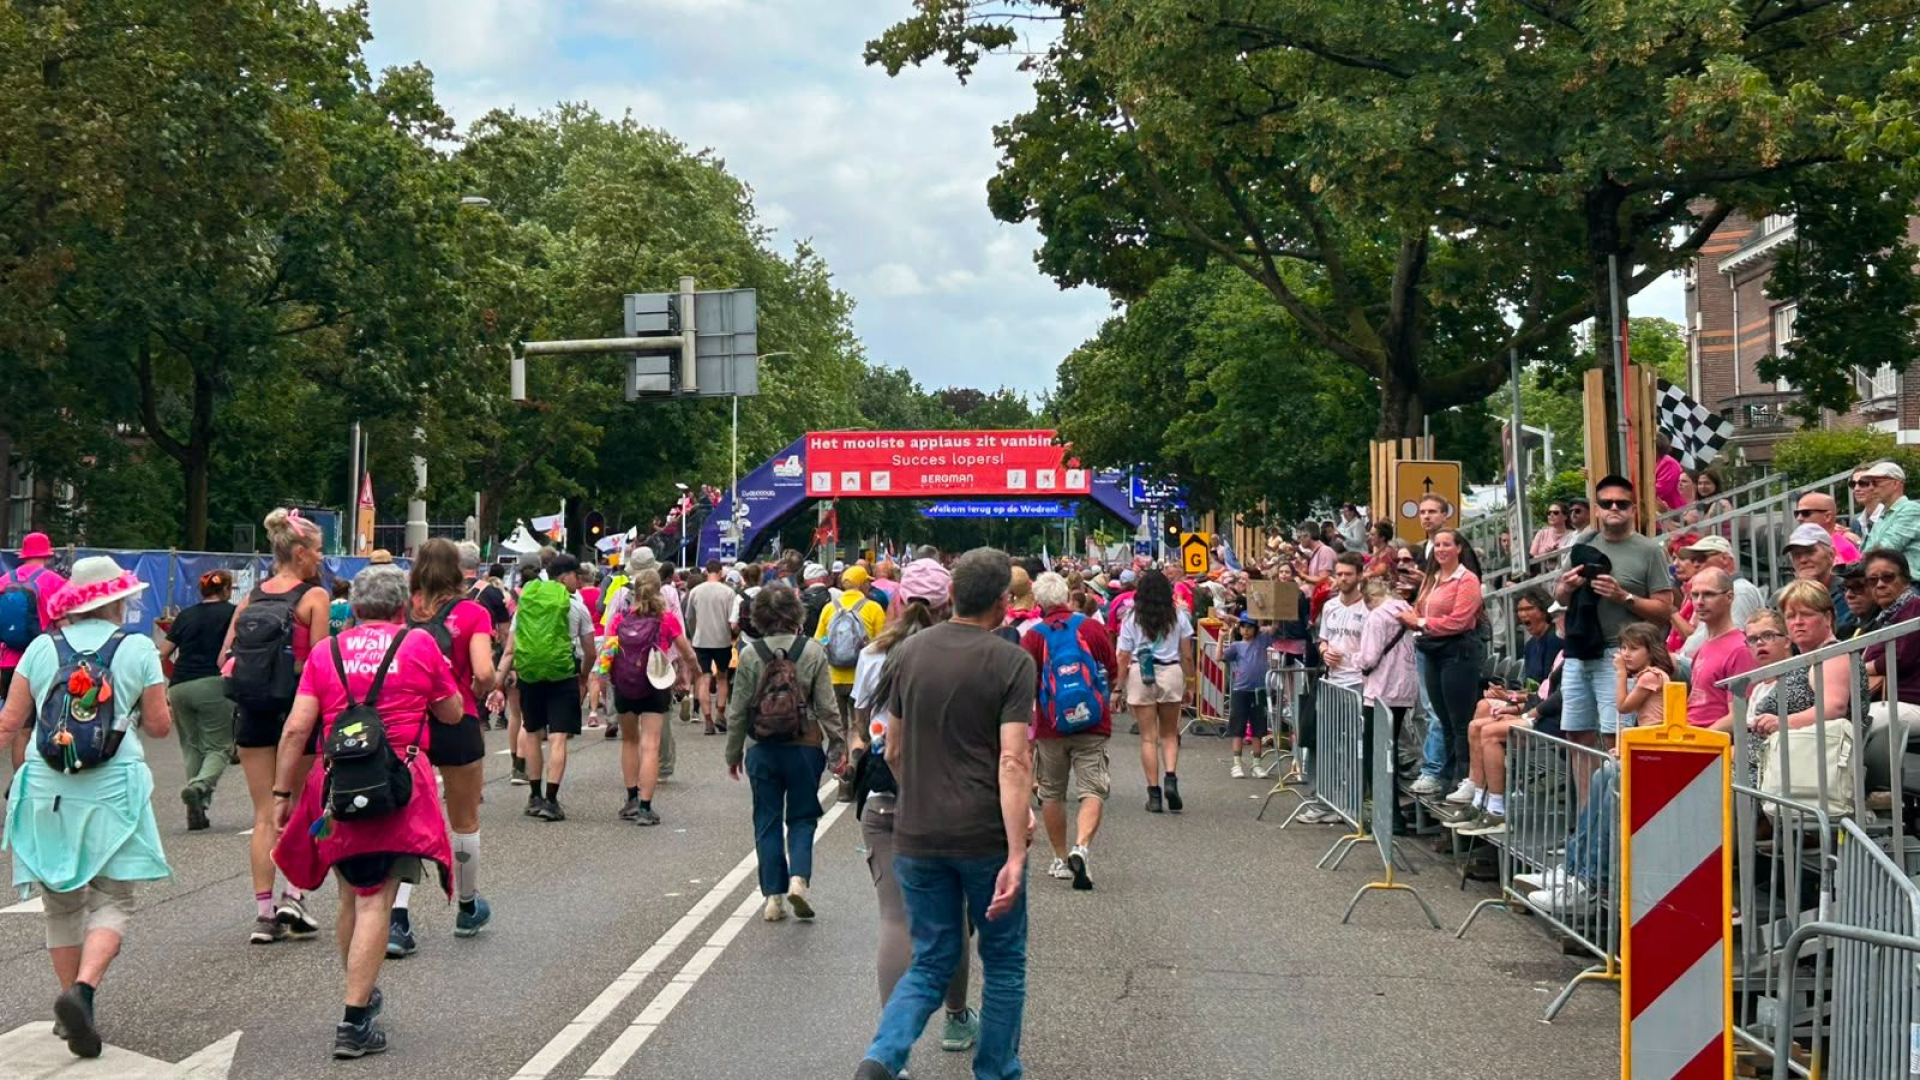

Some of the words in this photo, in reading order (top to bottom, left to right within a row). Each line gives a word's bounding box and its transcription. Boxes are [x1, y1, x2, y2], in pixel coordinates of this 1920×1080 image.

[811, 437, 838, 449] Het
[843, 436, 905, 449] mooiste
[910, 435, 971, 450] applaus
[976, 435, 996, 447] zit
[1001, 434, 1053, 447] vanbin
[892, 454, 946, 466] Succes
[952, 453, 1004, 467] lopers!
[921, 473, 974, 484] BERGMAN
[967, 505, 991, 515] terug
[993, 506, 1005, 515] op
[1007, 505, 1018, 513] de
[1020, 505, 1059, 514] Wedren!
[1190, 553, 1202, 567] G
[346, 634, 391, 650] Wall
[343, 660, 398, 674] Word
